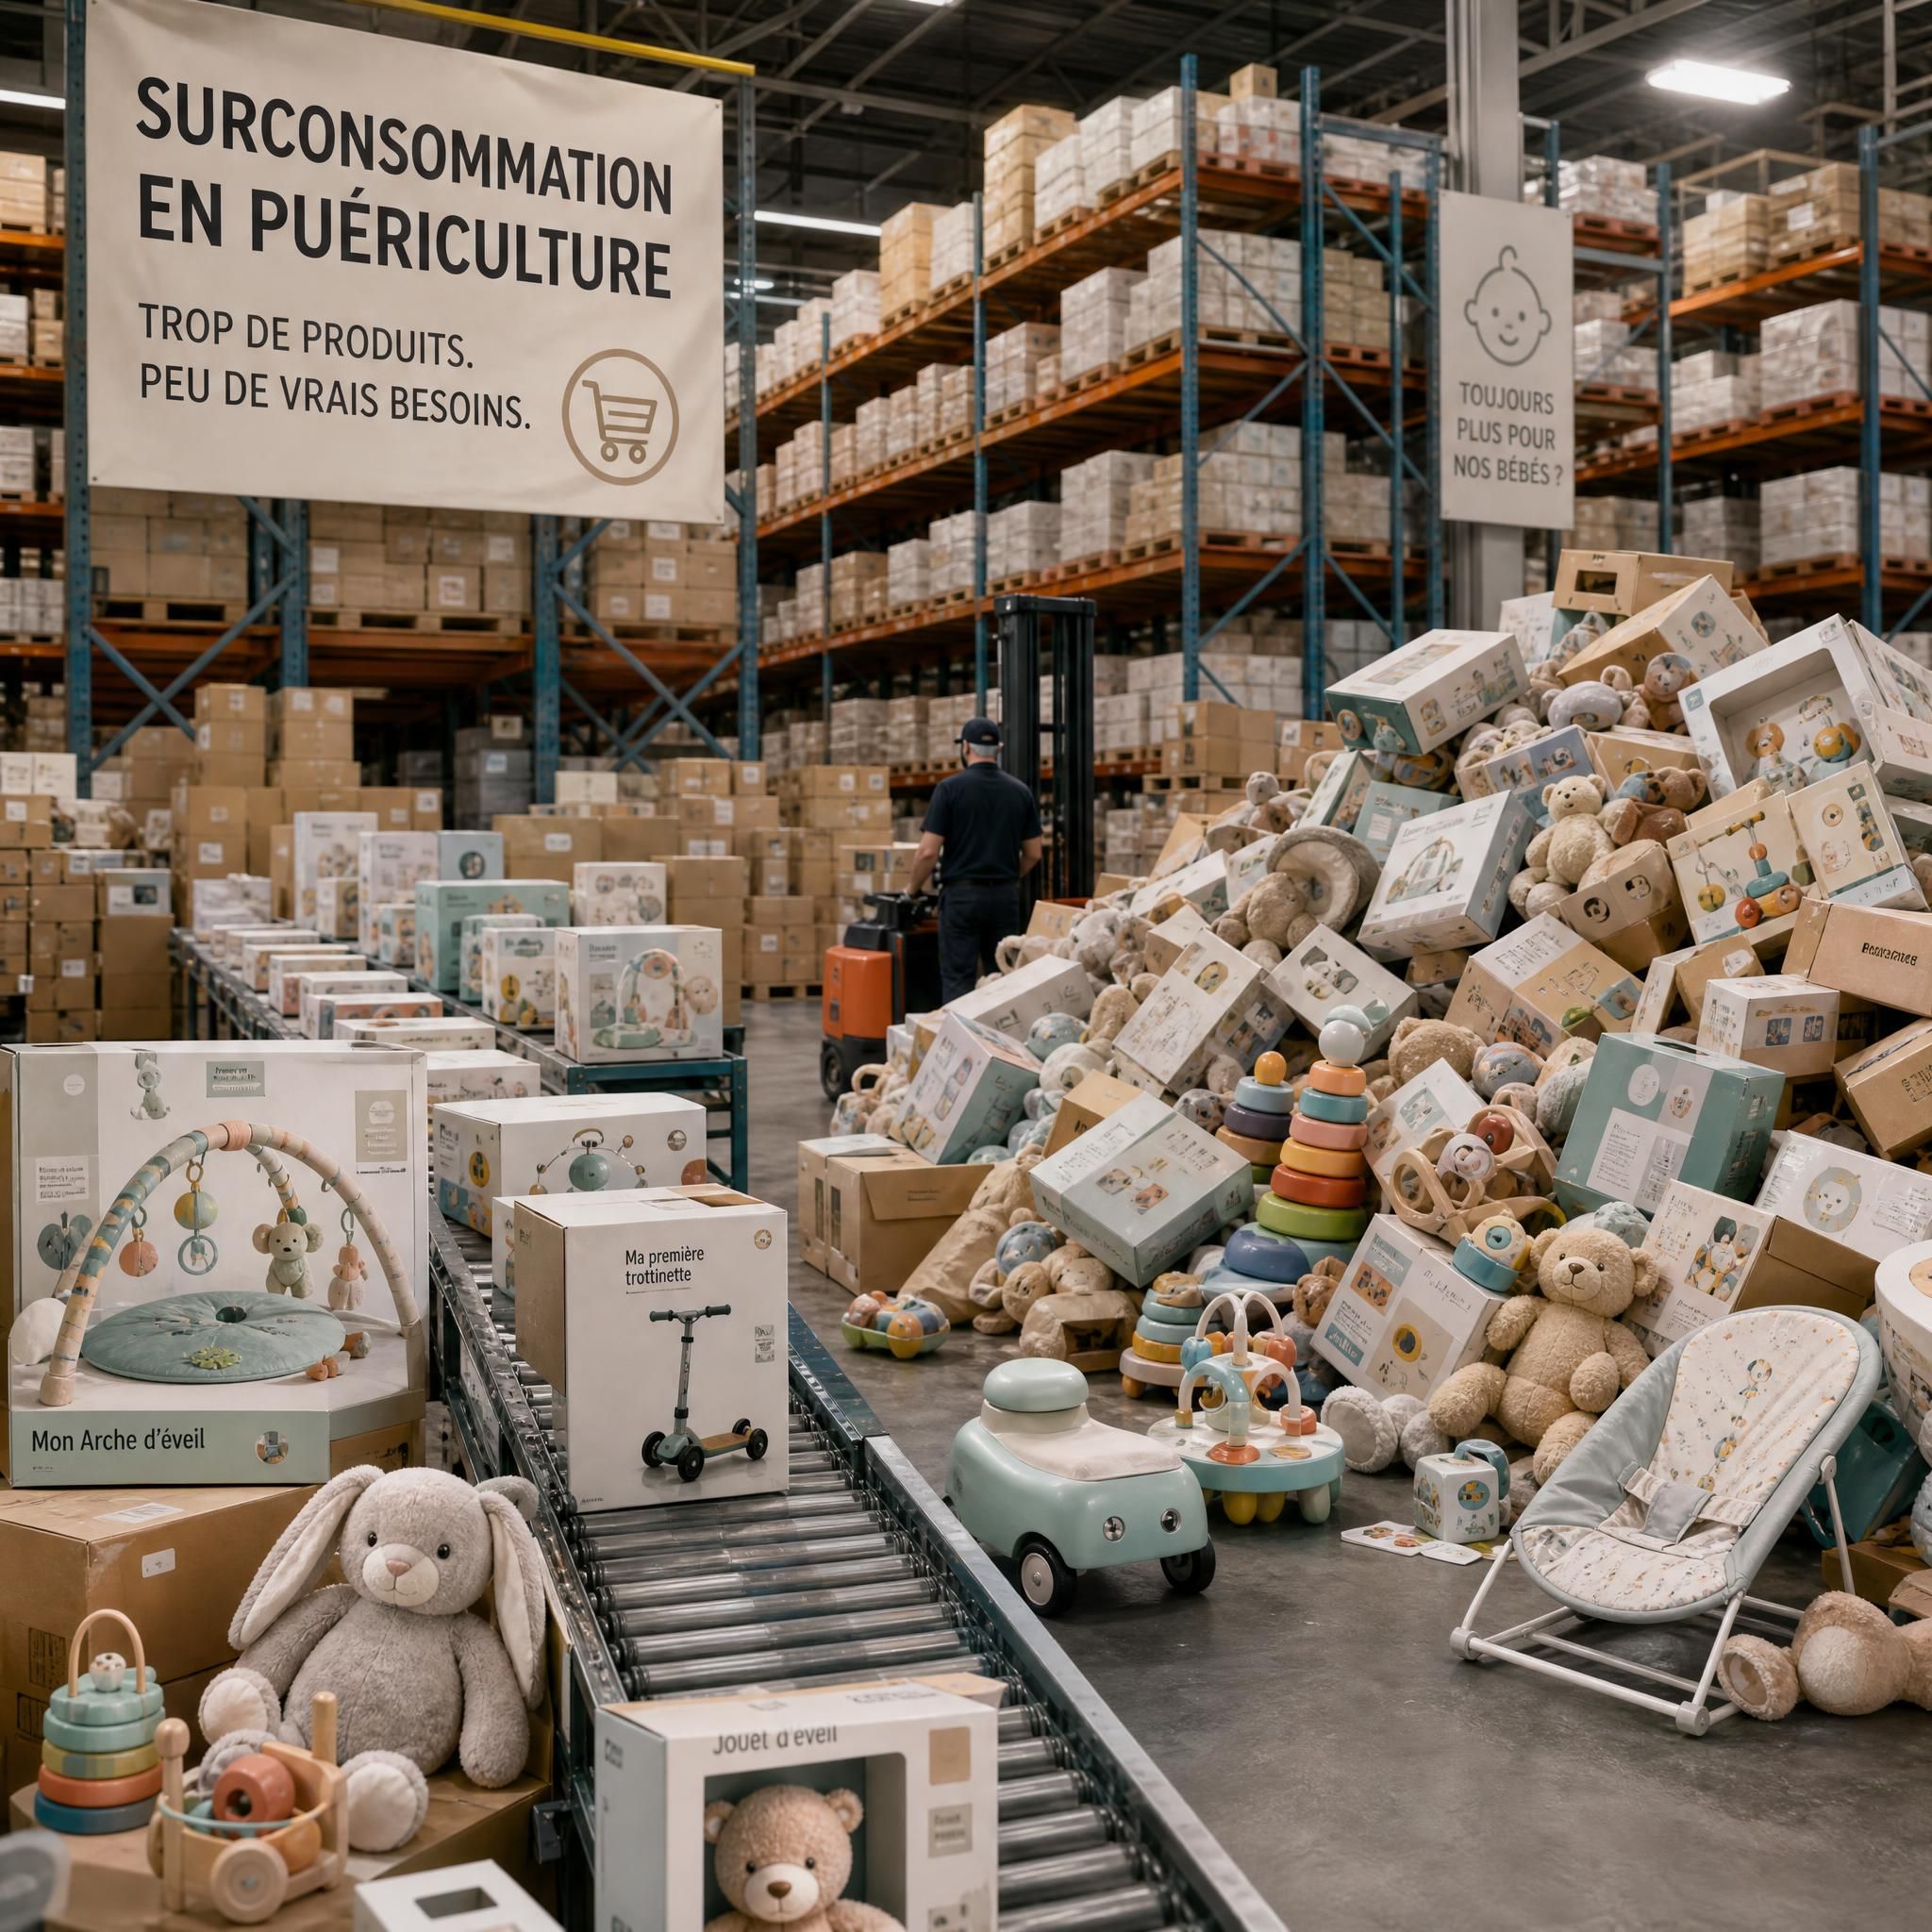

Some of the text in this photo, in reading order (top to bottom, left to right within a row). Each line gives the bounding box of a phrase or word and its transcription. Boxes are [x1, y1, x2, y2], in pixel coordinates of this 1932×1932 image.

[137, 77, 672, 215] SURCONSOMMATION
[141, 174, 672, 300] EN PUÉRICULTURE
[139, 303, 474, 369] TROP DE PRODUITS.
[141, 363, 531, 430] PEU DE VRAIS BESOINS.
[1459, 382, 1555, 415] TOUJOURS
[1457, 417, 1556, 450] PLUS POUR
[1454, 454, 1491, 479] NOS
[1497, 455, 1550, 485] BÉBÉS
[625, 1245, 705, 1269] Ma première
[625, 1267, 691, 1286] trottinette
[31, 1426, 206, 1453] Mon Arche d'éveil
[713, 1730, 769, 1755] Jouet
